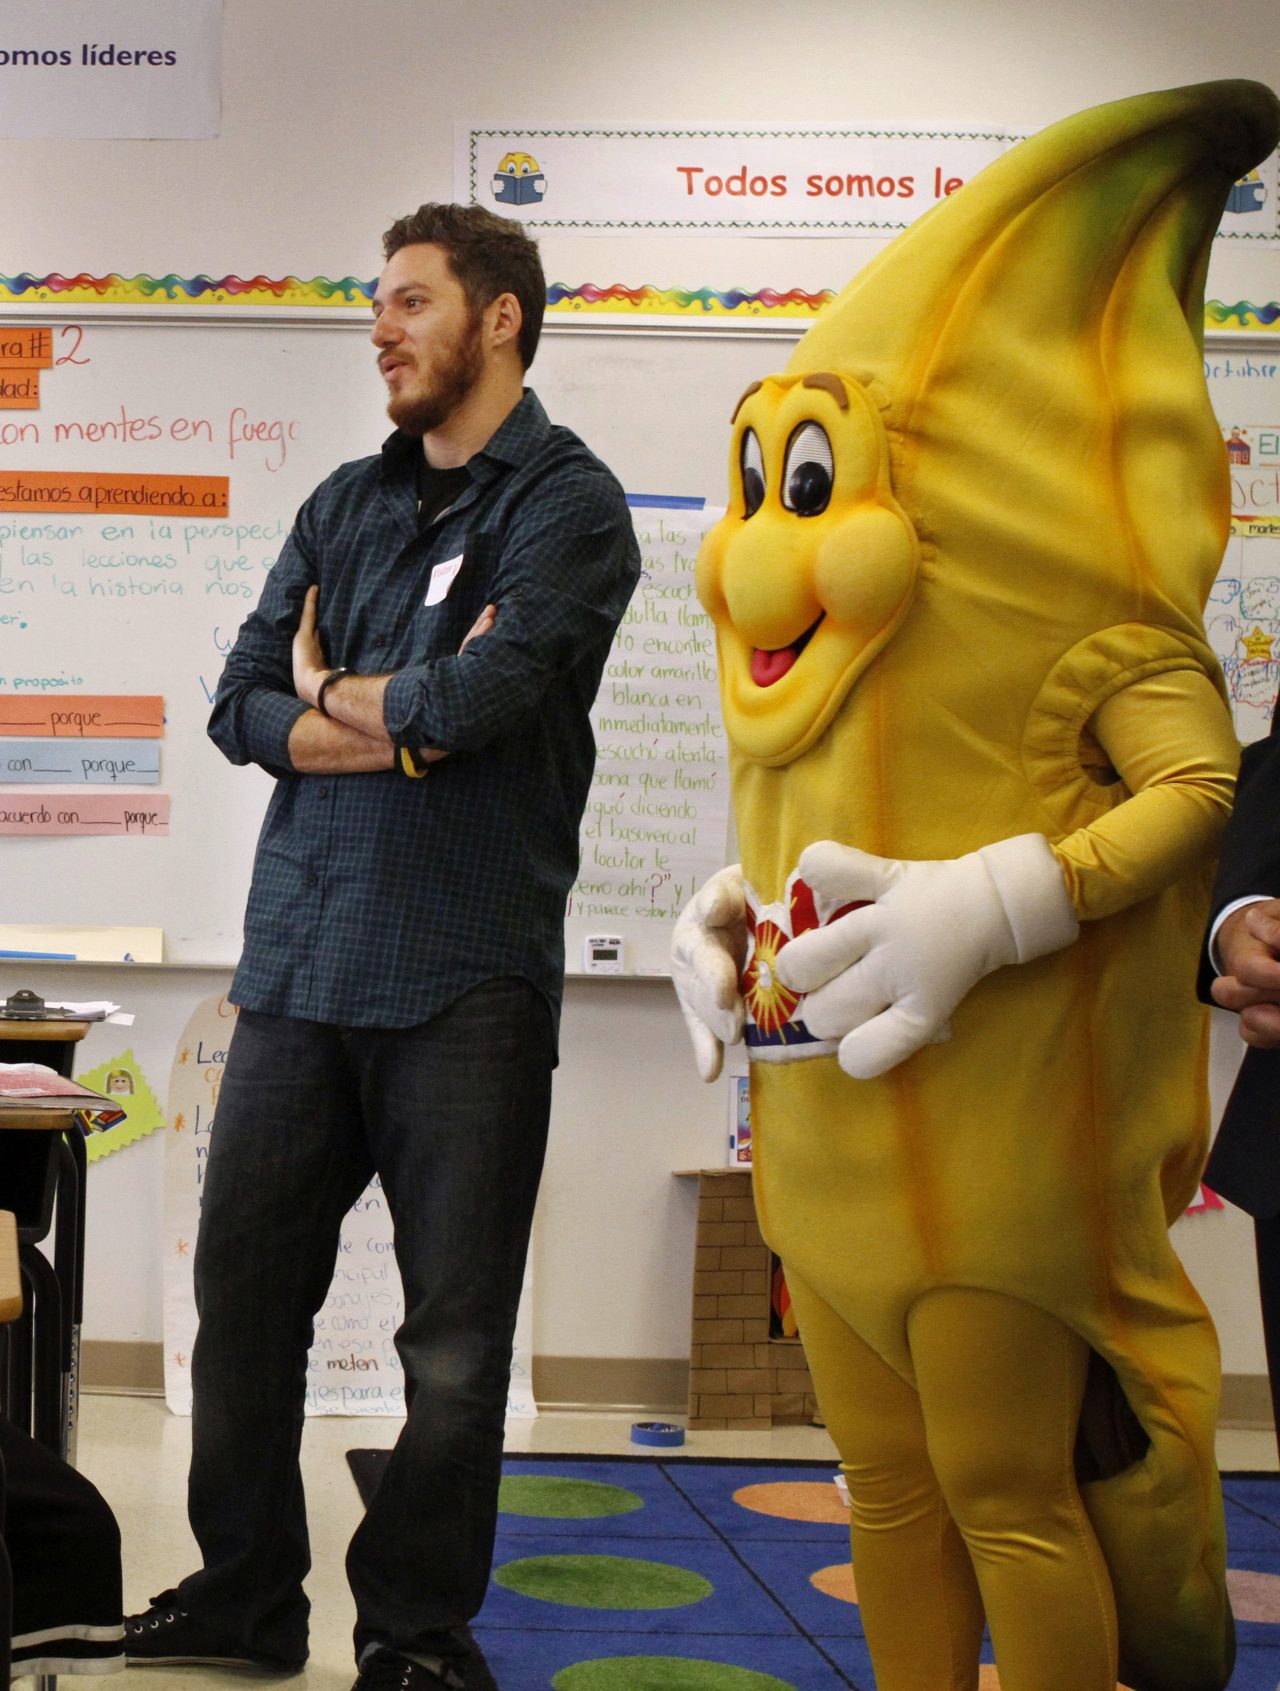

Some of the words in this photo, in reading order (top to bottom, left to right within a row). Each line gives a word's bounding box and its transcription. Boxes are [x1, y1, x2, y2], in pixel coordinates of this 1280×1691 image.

[82, 44, 177, 66] líderes
[677, 166, 788, 198] Todos
[807, 172, 915, 199] somos
[55, 325, 91, 366] 2
[55, 405, 162, 443] mentes
[170, 417, 213, 442] en
[79, 485, 195, 509] aprendiendo
[101, 524, 135, 541] en
[150, 519, 173, 541] la
[660, 520, 687, 545] las
[21, 545, 54, 567] las
[82, 549, 178, 569] lecciones
[205, 554, 255, 581] que
[89, 577, 184, 598] historia
[205, 581, 254, 599] nos
[651, 661, 717, 683] amarillo
[612, 682, 670, 706] blanca
[675, 693, 702, 710] en
[50, 709, 102, 737] porque
[599, 713, 723, 738] inmediatamente
[7, 755, 34, 772] con
[81, 757, 137, 783] porque
[639, 773, 669, 795] que
[57, 806, 81, 824] con
[123, 810, 160, 835] porque
[631, 799, 698, 819] diciendo
[679, 828, 697, 846] al
[594, 844, 647, 869] locutor
[655, 848, 671, 870] le
[327, 1354, 379, 1371] meten
[342, 1386, 383, 1407] para
